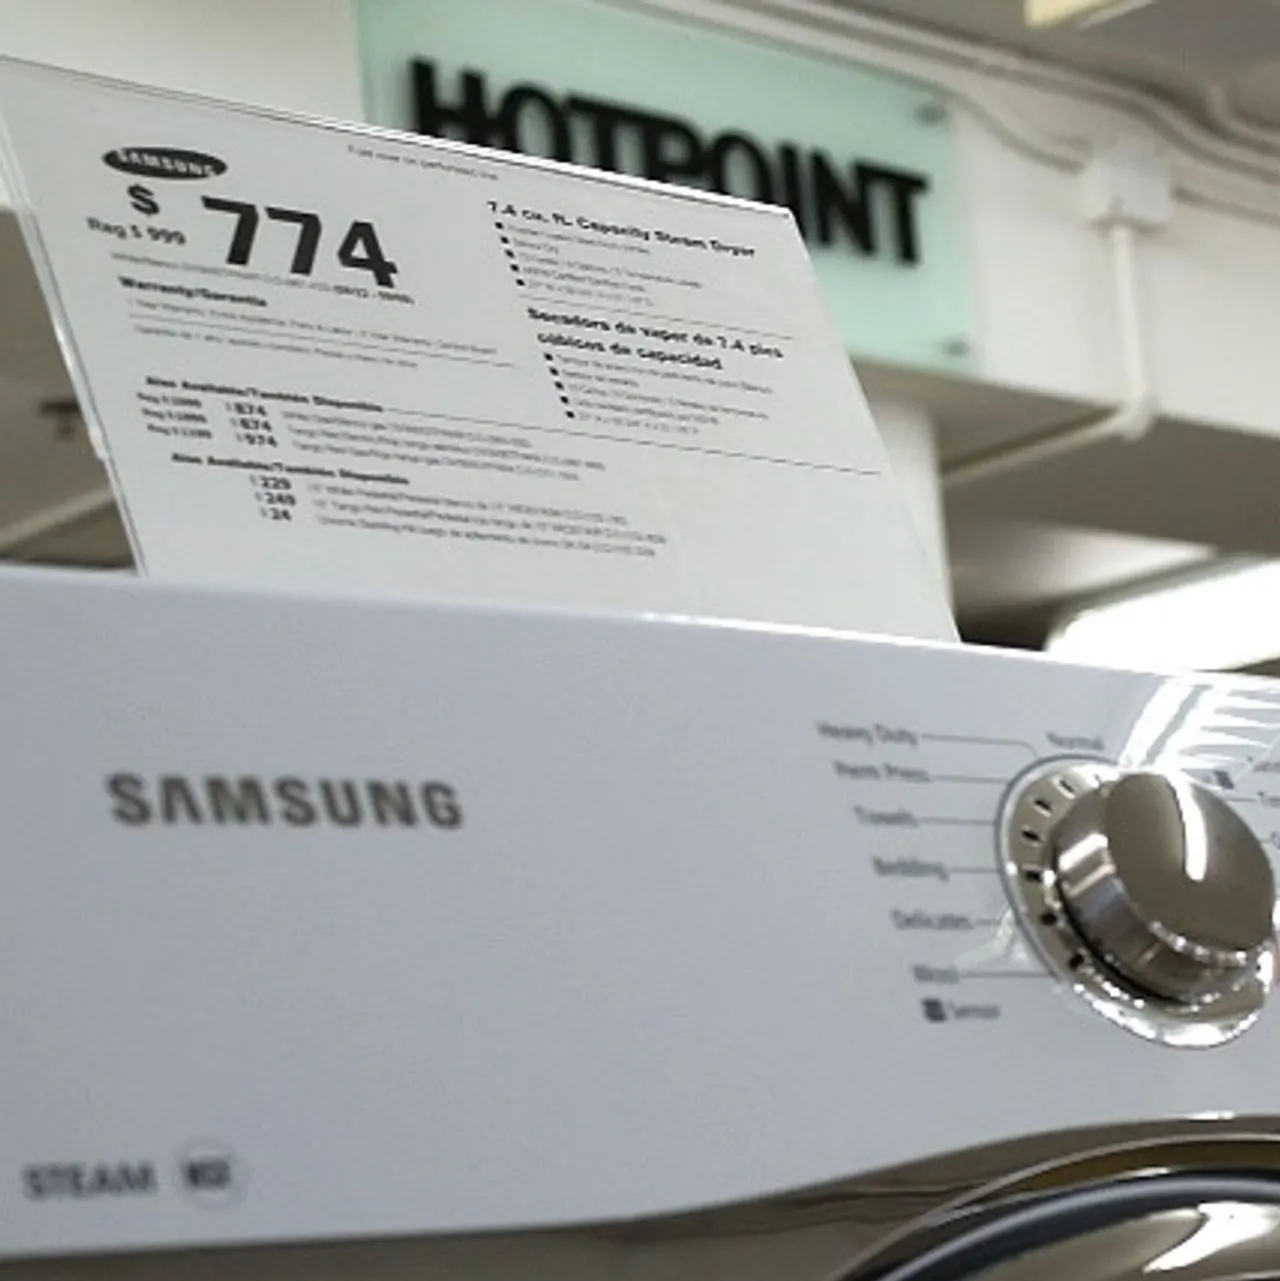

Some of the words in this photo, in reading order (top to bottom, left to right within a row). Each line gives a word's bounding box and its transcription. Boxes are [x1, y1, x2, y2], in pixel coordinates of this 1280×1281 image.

[408, 56, 928, 268] HOTPOINT
[127, 183, 160, 217] $
[201, 195, 398, 291] 774
[146, 226, 187, 245] 999
[576, 216, 650, 242] Capacity
[104, 771, 466, 830] SAMSUNG
